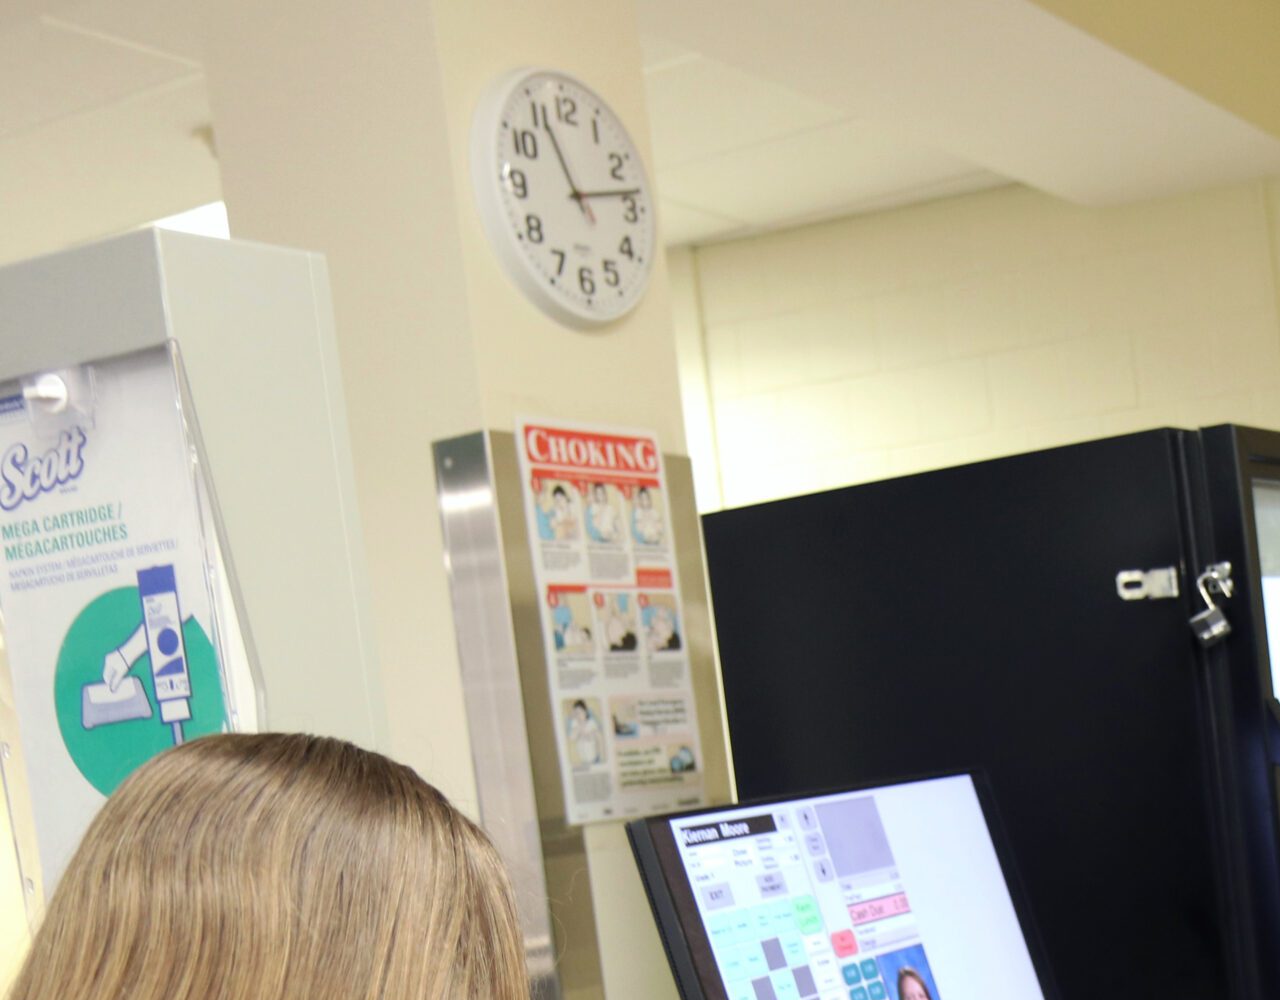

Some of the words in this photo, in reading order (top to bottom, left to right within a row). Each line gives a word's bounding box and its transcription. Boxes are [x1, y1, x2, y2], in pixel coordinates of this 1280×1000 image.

[556, 96, 578, 126] 12
[513, 129, 538, 160] 10
[591, 117, 599, 144] 1
[608, 153, 625, 181] 2
[510, 170, 528, 200] 9
[623, 196, 639, 224] 3
[525, 214, 544, 244] 8
[551, 249, 566, 276] 7
[619, 236, 634, 261] 4
[578, 268, 597, 296] 6
[602, 260, 621, 287] 5
[528, 429, 657, 470] CHOKING
[0, 425, 87, 511] Scott
[1, 519, 40, 541] MEGA
[43, 503, 115, 532] CARTRIDGE
[682, 827, 720, 845] Kiernan
[719, 822, 750, 838] Moore
